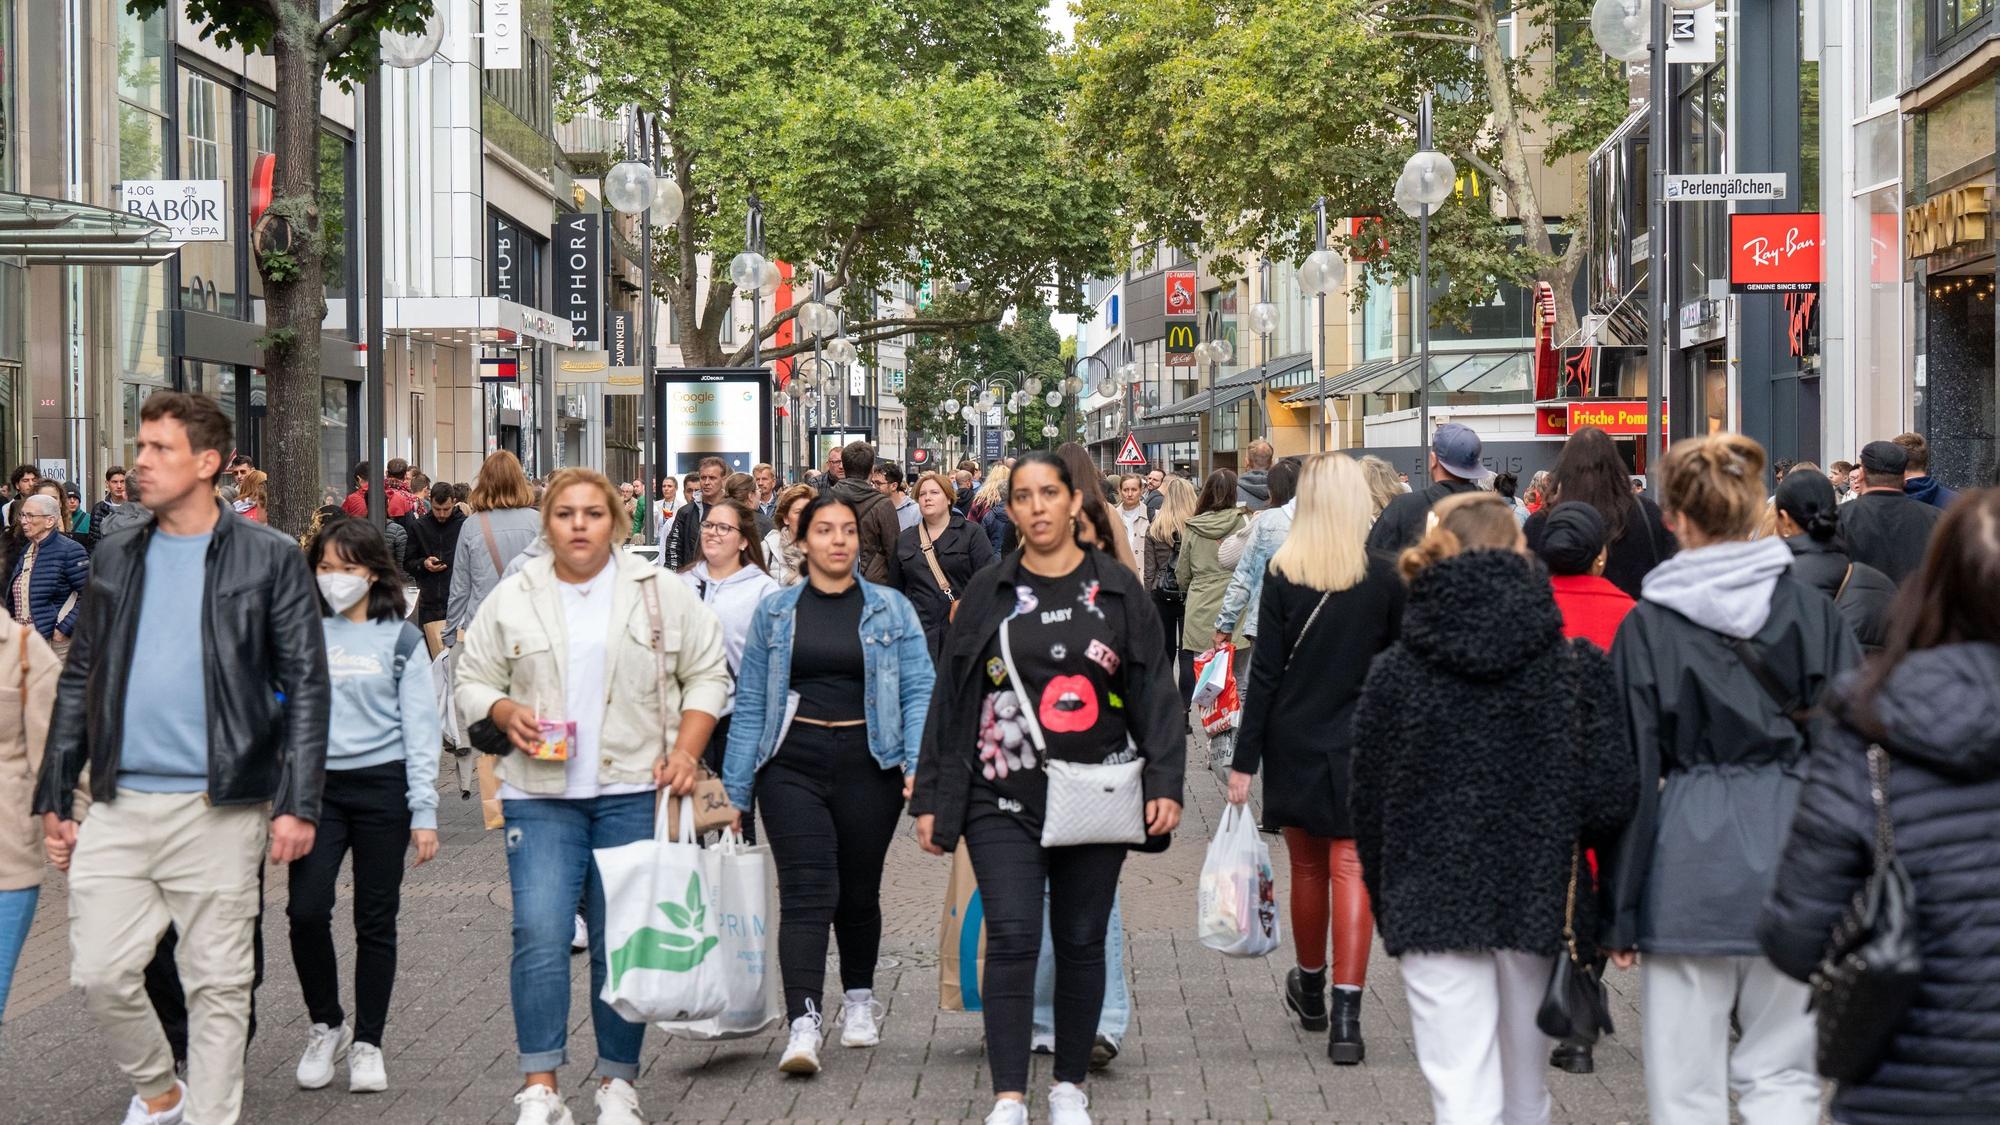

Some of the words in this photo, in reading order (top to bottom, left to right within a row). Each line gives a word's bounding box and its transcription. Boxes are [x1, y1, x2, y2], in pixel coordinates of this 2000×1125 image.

[127, 185, 154, 195] 4.OG
[1681, 179, 1772, 198] Perlengäßchen
[127, 199, 219, 222] BABOR
[191, 226, 219, 236] SPA
[1743, 227, 1815, 267] Ray-Ban
[570, 217, 587, 337] SEPHORA
[615, 316, 625, 339] KLEIN
[615, 340, 625, 368] CALVIN
[673, 391, 715, 405] Google
[1574, 410, 1615, 425] Frische
[1618, 410, 1668, 425] Poms
[42, 467, 67, 480] ABOR
[1041, 608, 1073, 625] BABY
